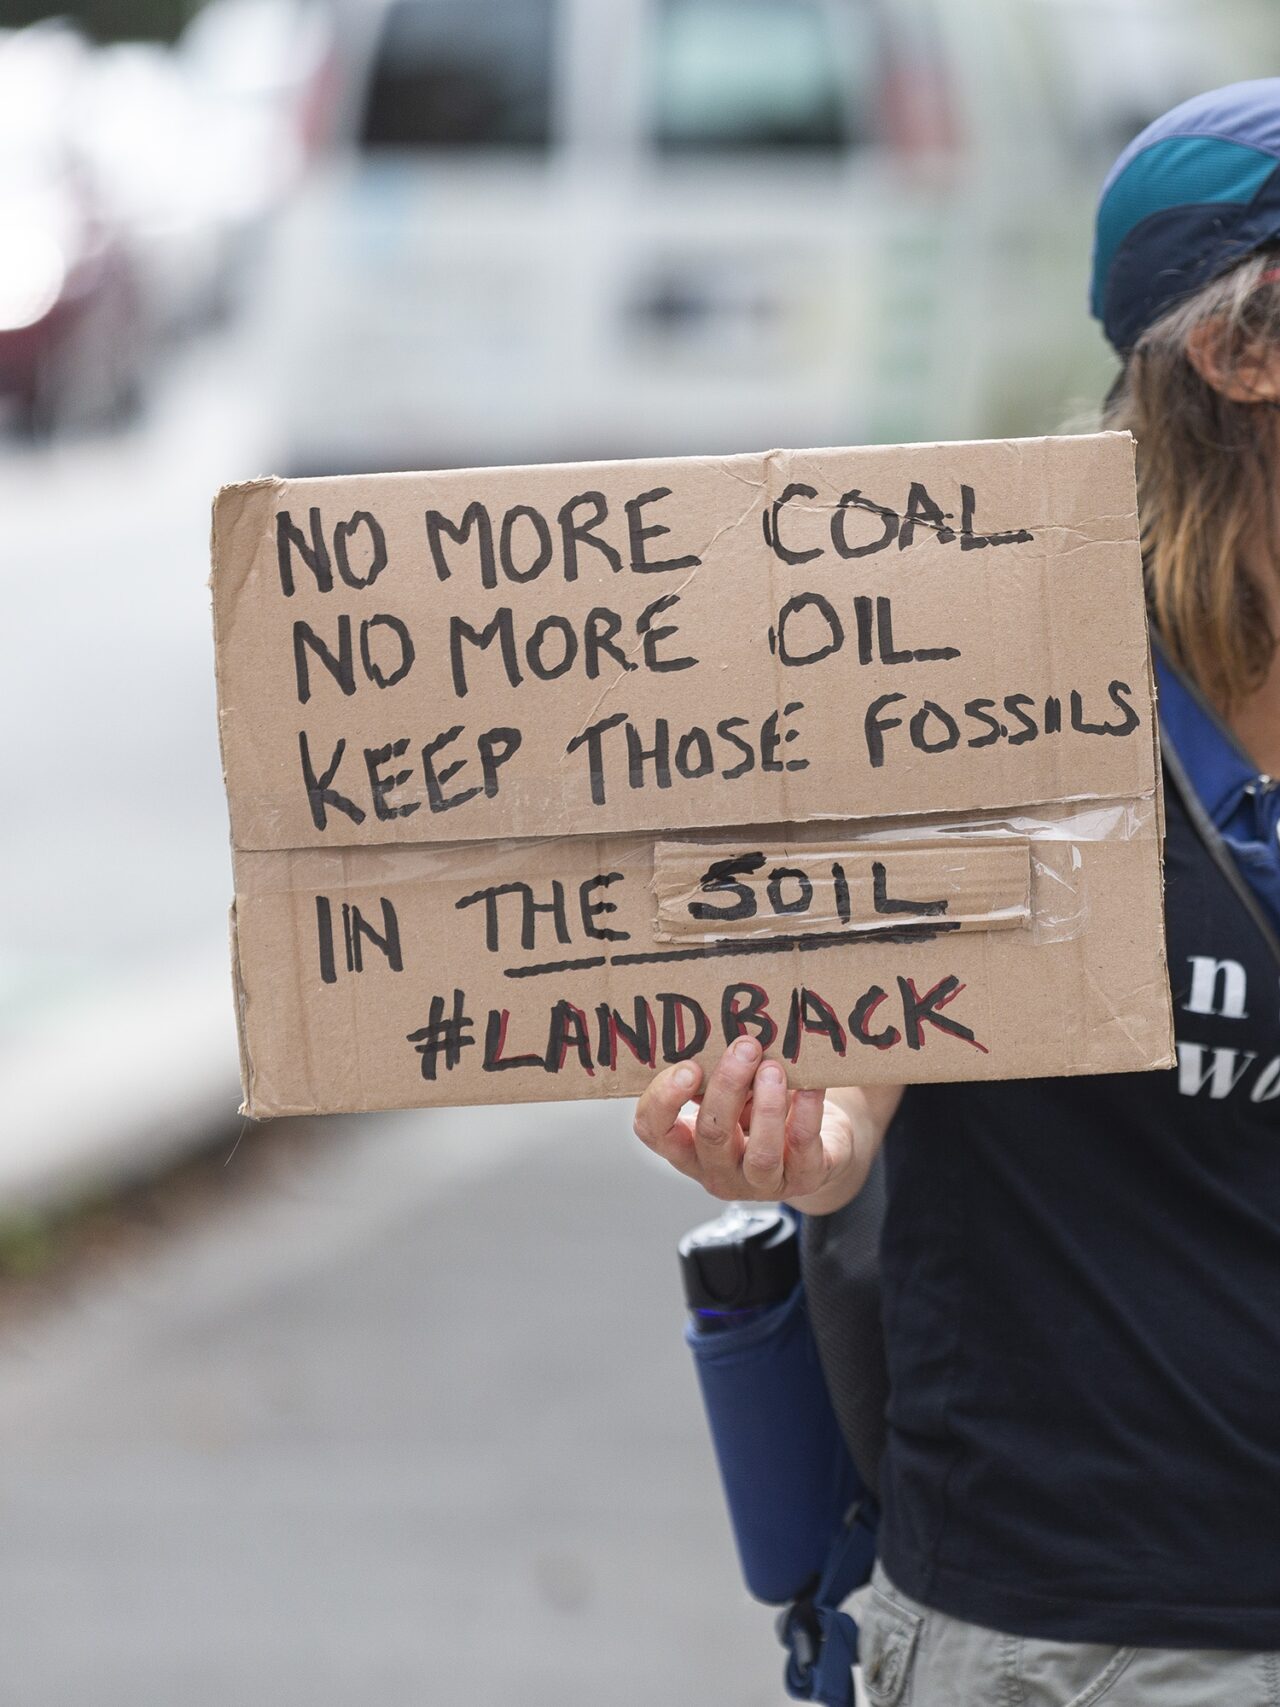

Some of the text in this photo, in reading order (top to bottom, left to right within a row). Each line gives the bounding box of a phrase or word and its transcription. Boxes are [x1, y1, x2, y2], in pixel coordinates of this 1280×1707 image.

[275, 482, 1034, 598] NO MORE COAL
[293, 591, 962, 705] NO MORE OIL
[299, 679, 1141, 832] KEEP THOSE FOSSILS
[315, 850, 949, 984] IN THE SOIL
[405, 975, 990, 1082] #LANDBACK
